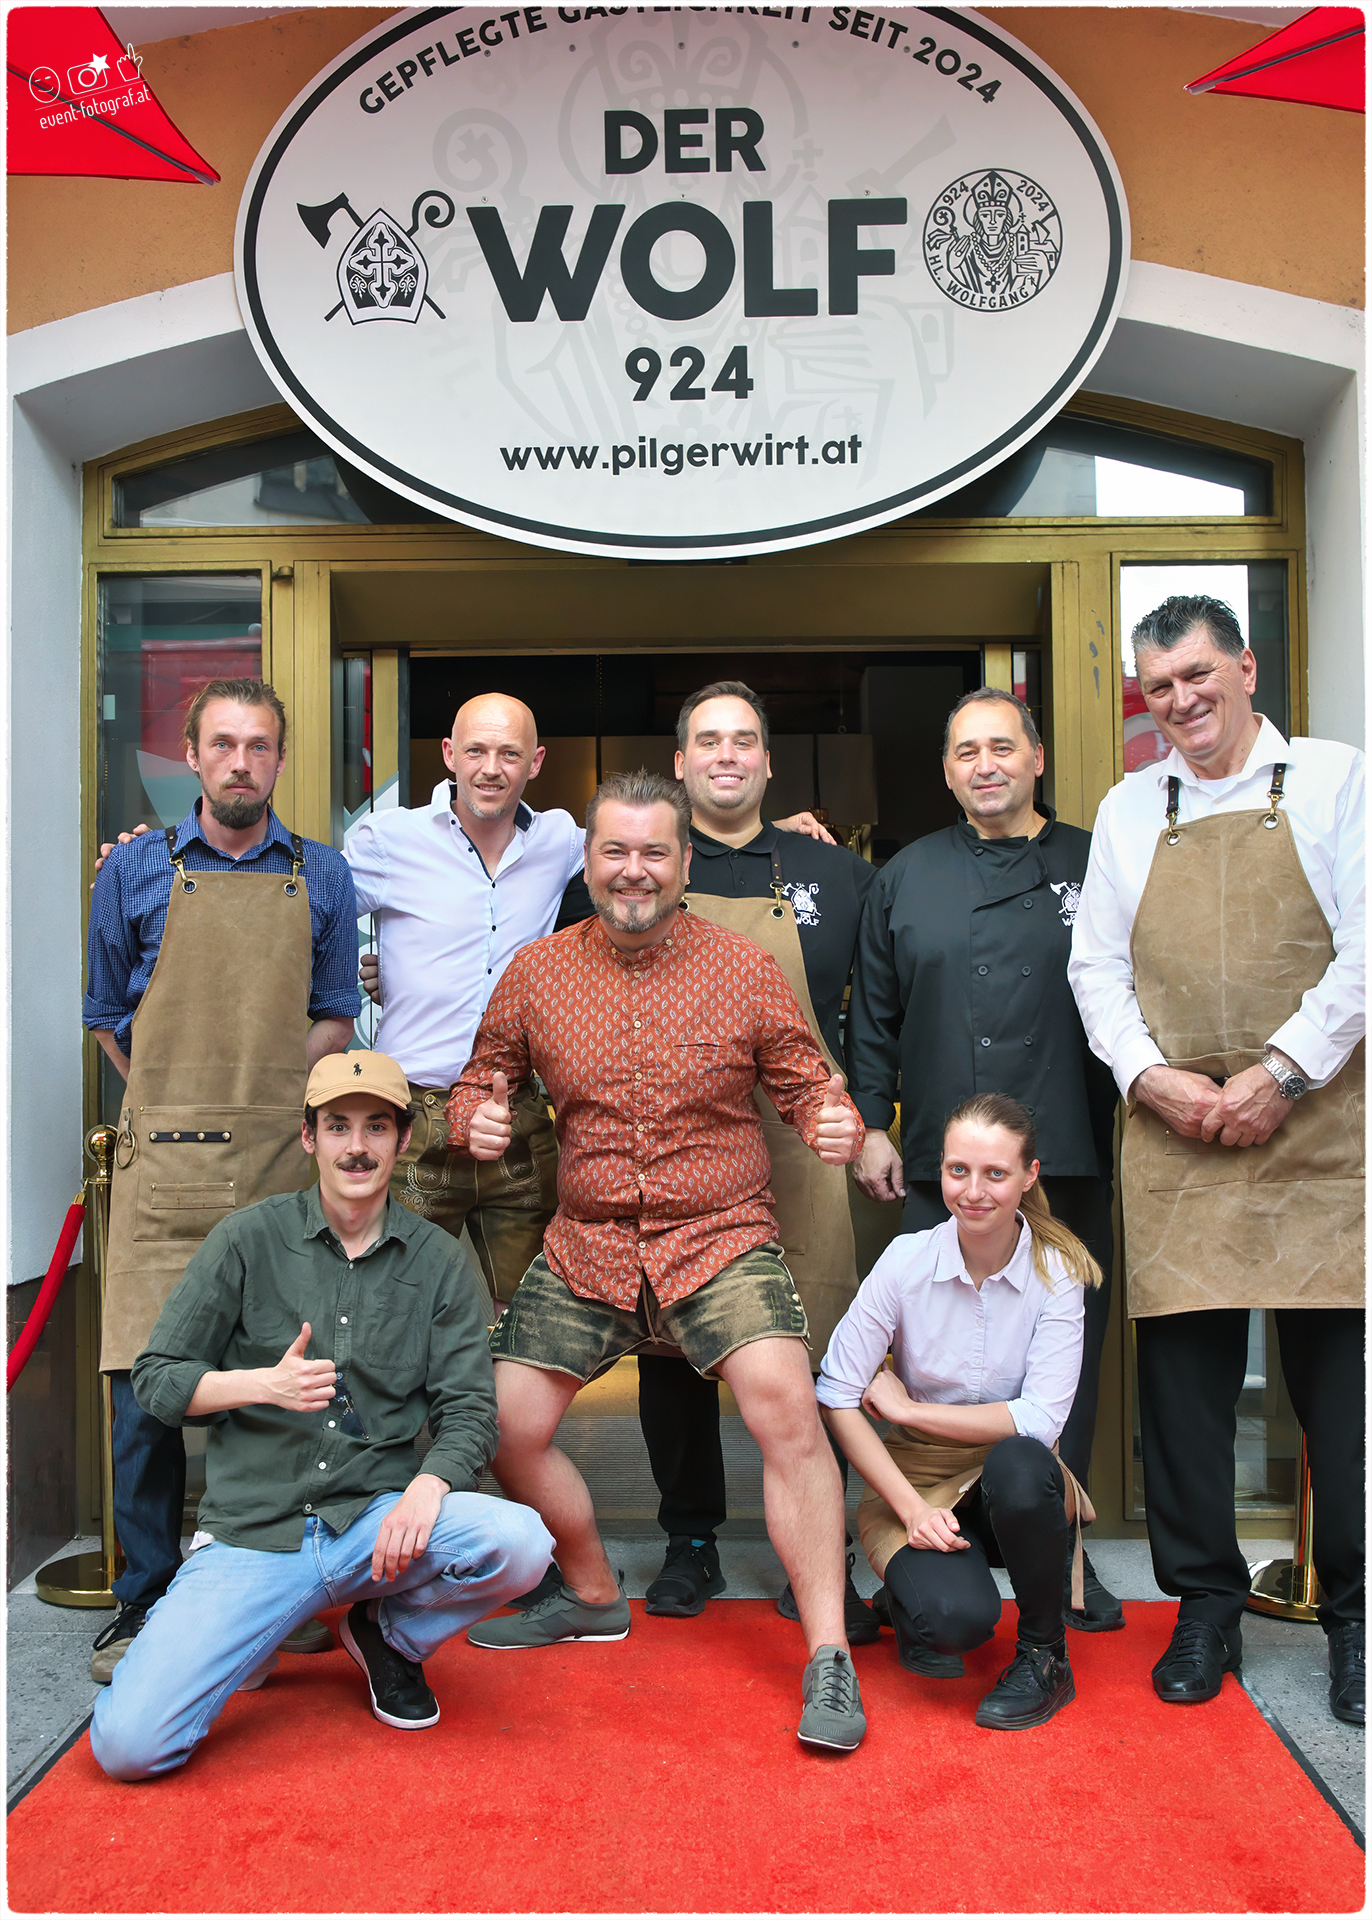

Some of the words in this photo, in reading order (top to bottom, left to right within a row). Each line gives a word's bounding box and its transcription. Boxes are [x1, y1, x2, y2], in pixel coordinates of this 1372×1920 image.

[359, 6, 548, 114] GEPFLEGTE
[828, 6, 909, 49] SEIT
[912, 36, 1002, 104] 2024
[604, 107, 767, 175] DER
[942, 179, 970, 207] 924
[1016, 178, 1051, 212] 2024
[465, 197, 908, 323] WOLF
[927, 253, 945, 282] HL.
[945, 279, 1030, 309] WOLFGANG
[625, 345, 754, 402] 924
[499, 433, 862, 476] www.pilgerwirt.at
[794, 915, 820, 928] WOLF
